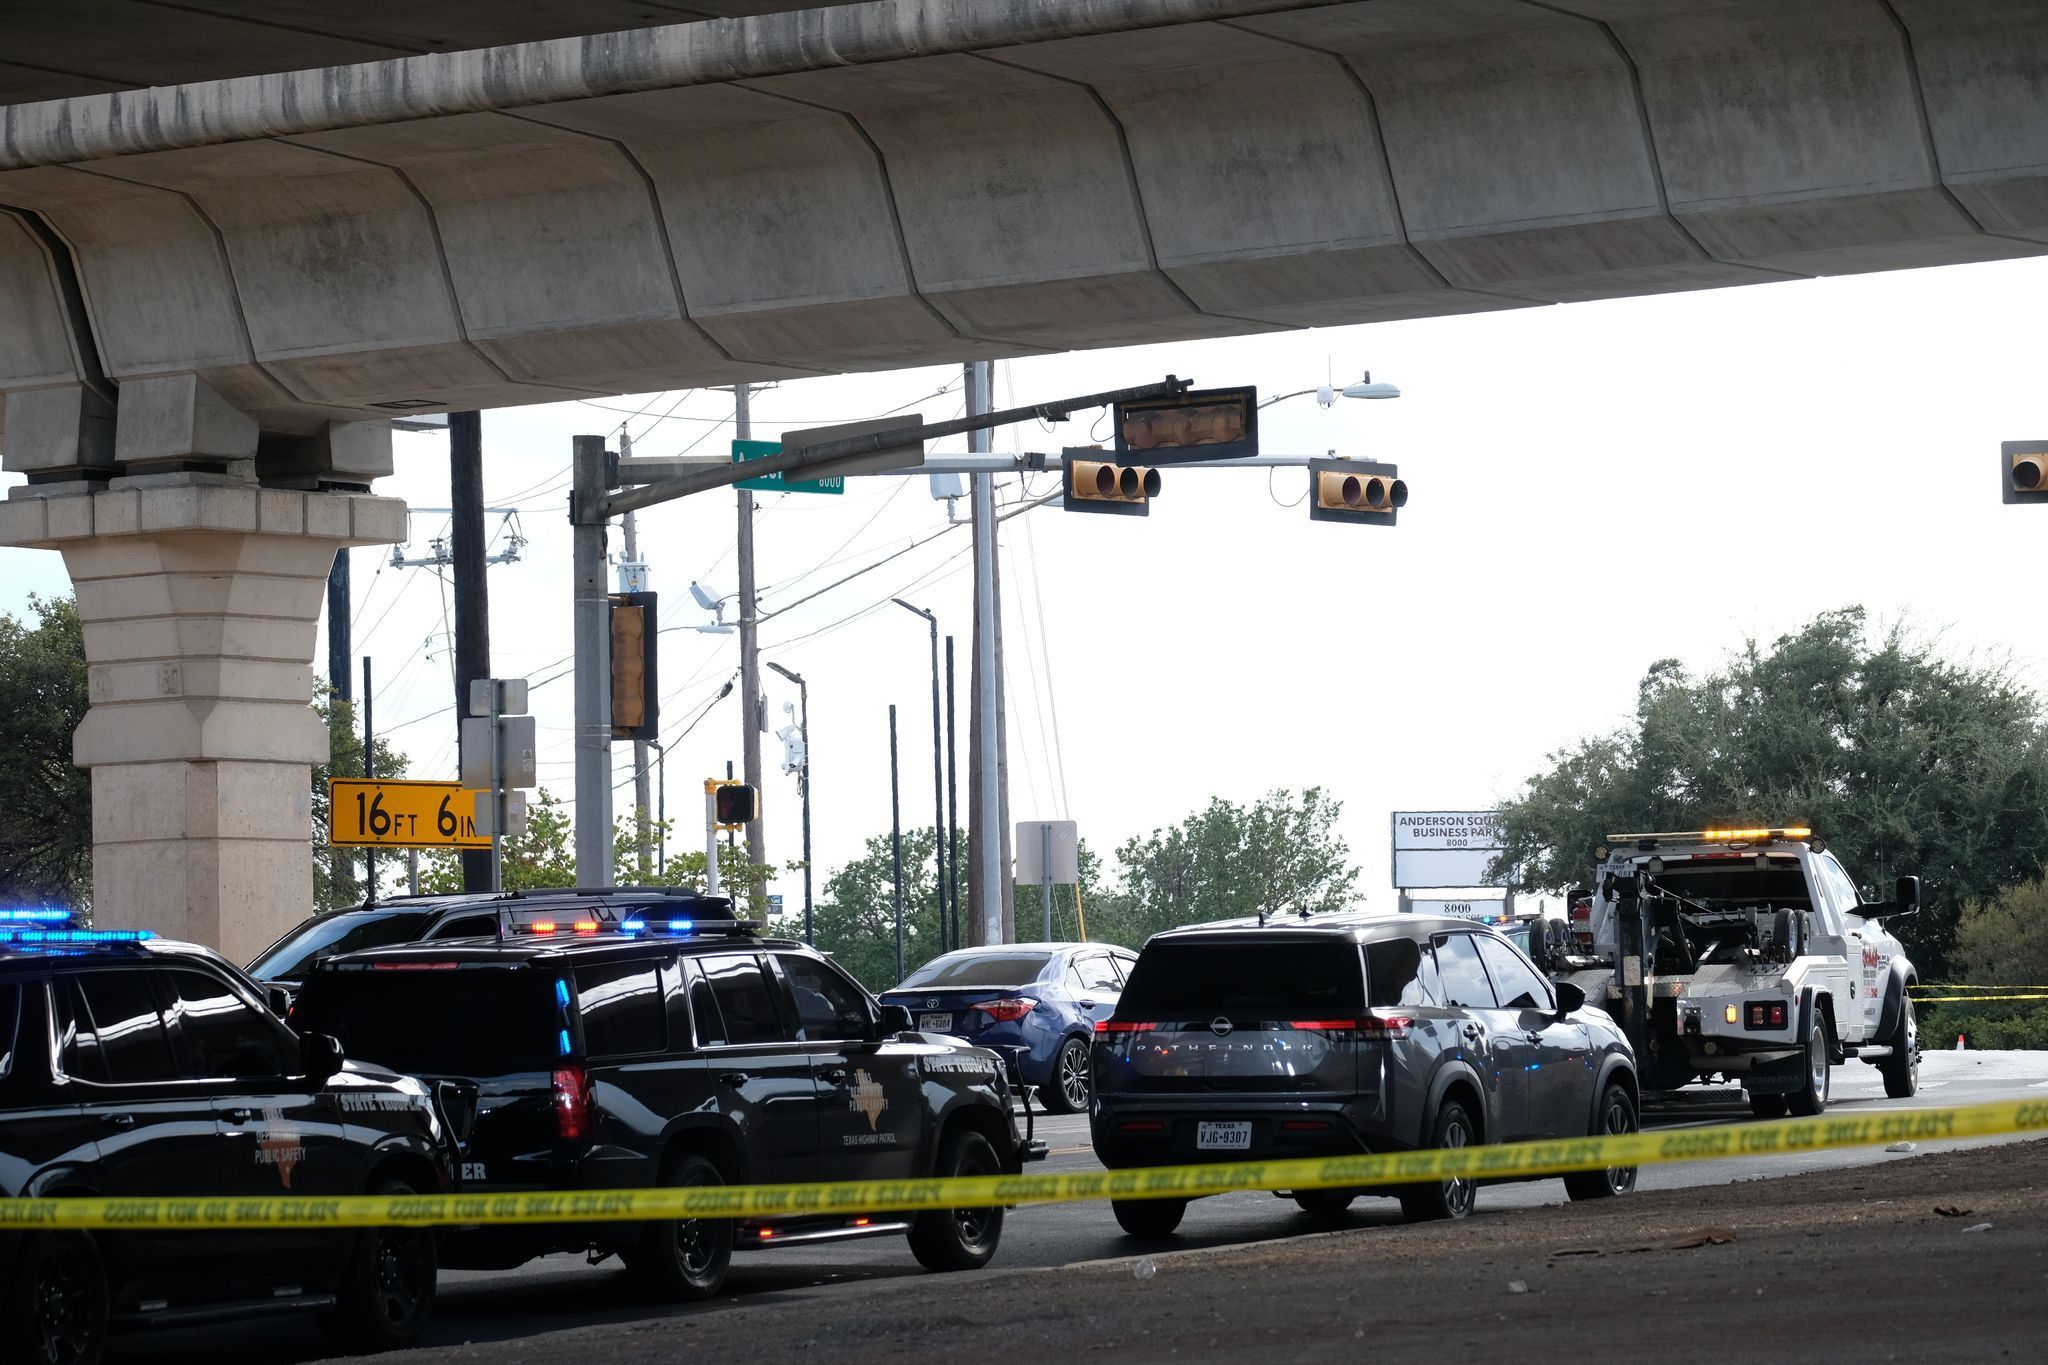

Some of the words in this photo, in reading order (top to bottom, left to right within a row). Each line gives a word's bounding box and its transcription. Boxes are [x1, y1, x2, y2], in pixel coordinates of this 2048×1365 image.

[1399, 816, 1465, 826] ANDERSON
[1413, 828, 1468, 837] BUSINESS
[1446, 838, 1468, 847] 8000
[1444, 903, 1472, 913] 8000
[1136, 1043, 1314, 1052] PATHFINDER
[843, 1135, 859, 1146] TEXAS
[879, 1132, 897, 1144] PATROL
[281, 1146, 307, 1162] SAFETY
